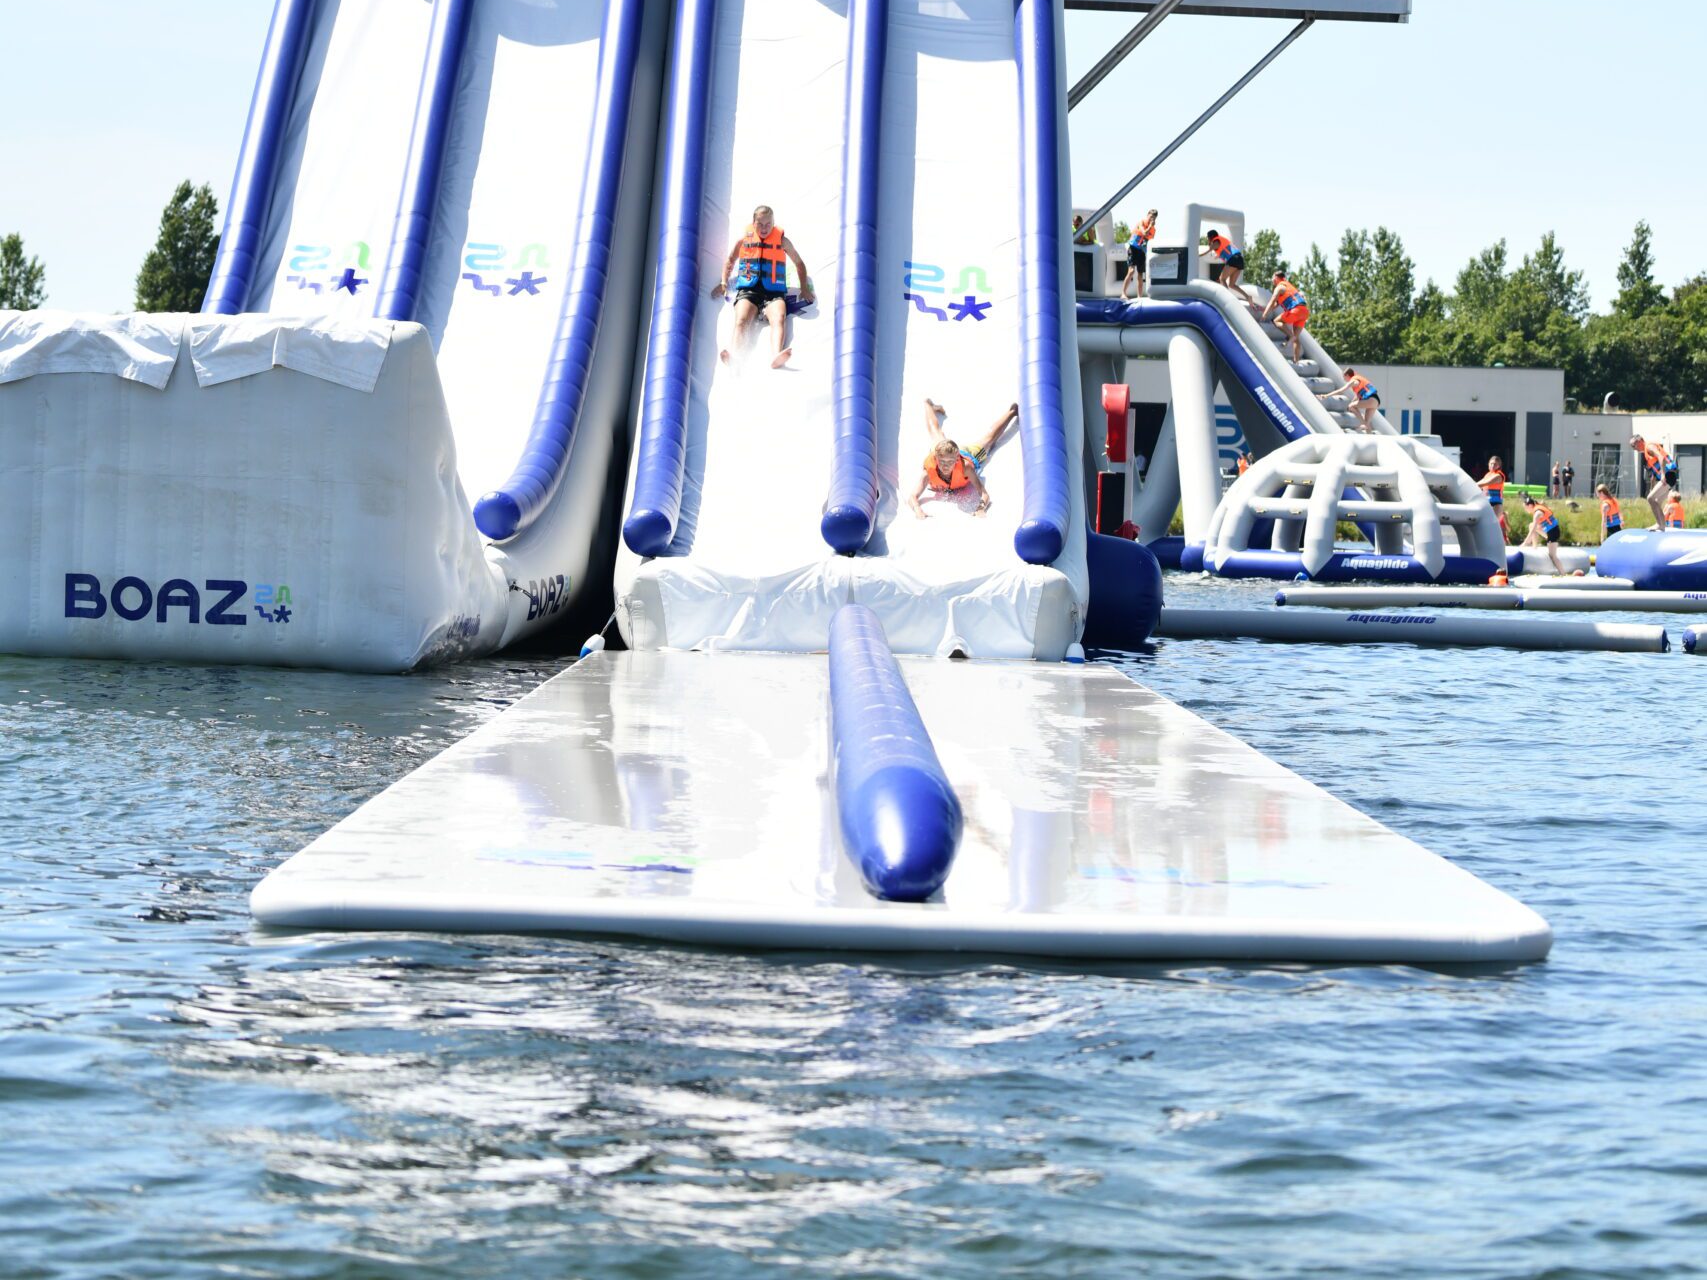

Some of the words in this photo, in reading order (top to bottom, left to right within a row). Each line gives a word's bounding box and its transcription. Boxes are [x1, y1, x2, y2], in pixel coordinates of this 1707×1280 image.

[1254, 385, 1296, 434] Aquaglide
[1341, 558, 1409, 570] Aquaglide
[64, 573, 248, 625] BOAZ
[526, 574, 565, 621] BOAZ
[1346, 614, 1437, 625] Aquaglide
